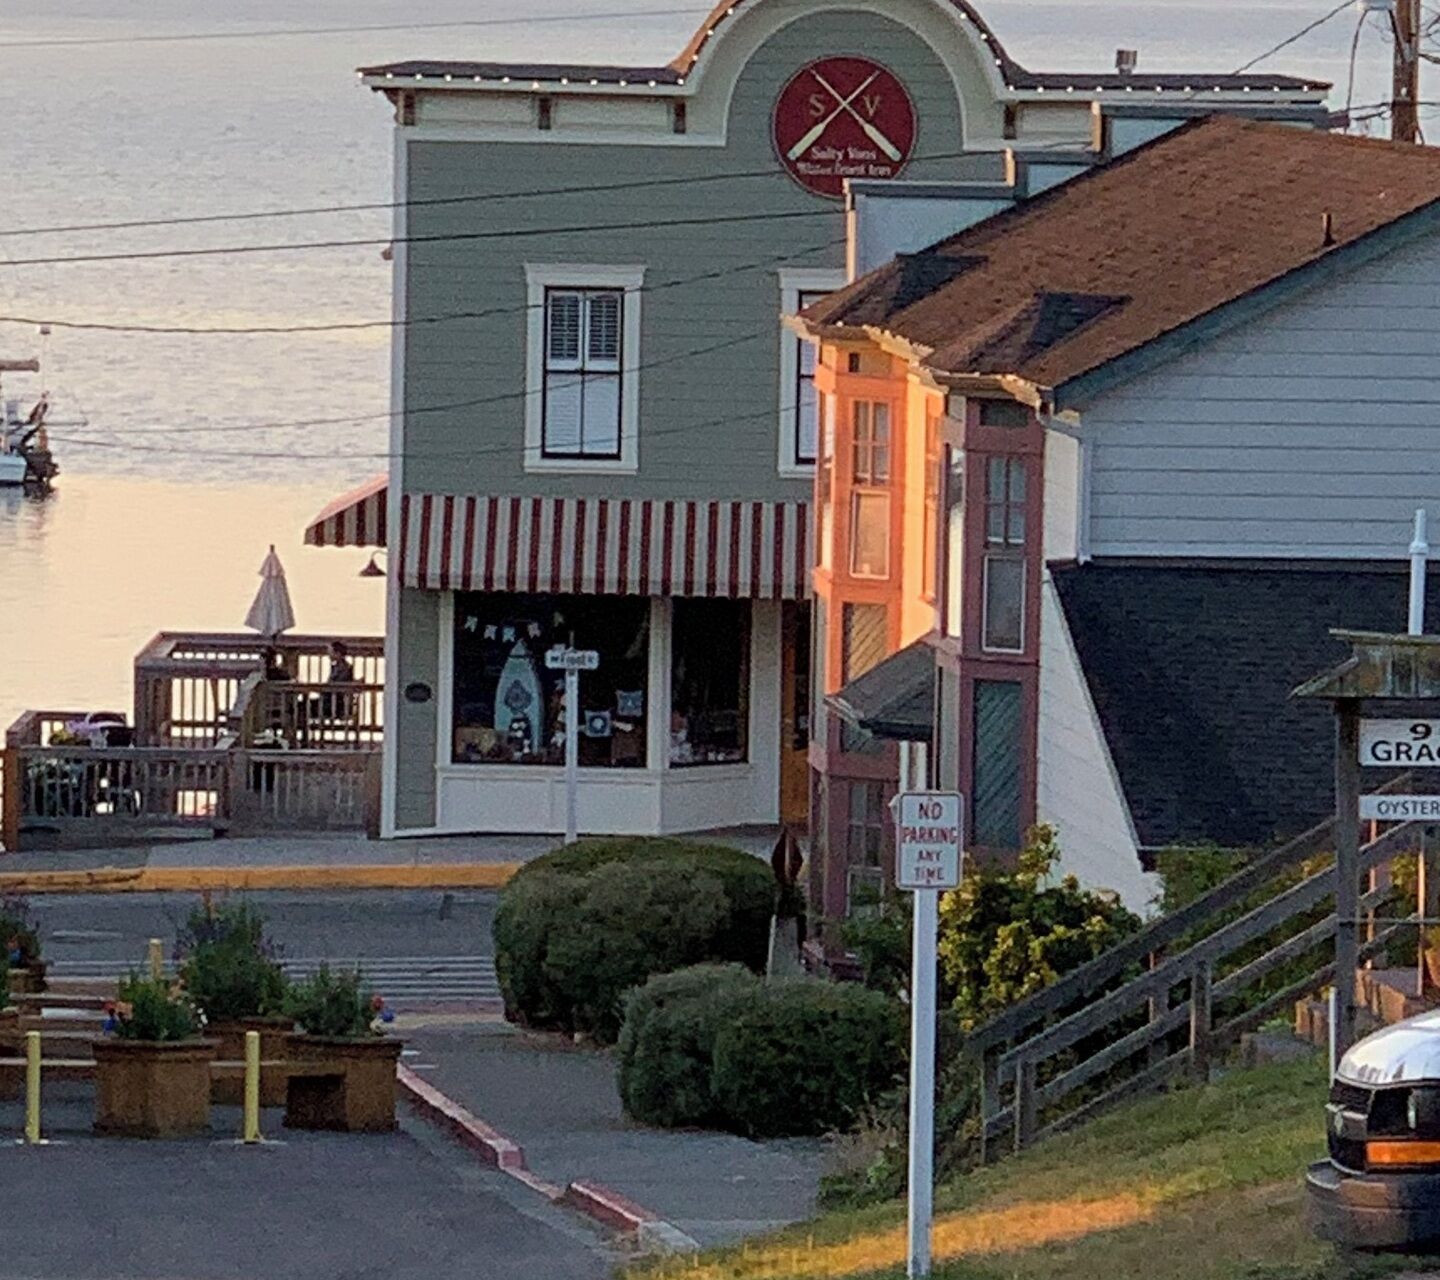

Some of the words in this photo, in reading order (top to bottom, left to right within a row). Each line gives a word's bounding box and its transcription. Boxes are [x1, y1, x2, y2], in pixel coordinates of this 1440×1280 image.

[808, 94, 825, 117] S
[863, 95, 880, 118] V
[1409, 723, 1432, 741] 9
[1371, 740, 1440, 762] GRA
[918, 802, 943, 821] NO
[901, 825, 959, 845] PARKING
[917, 850, 943, 862] ANY
[914, 866, 945, 882] TIME
